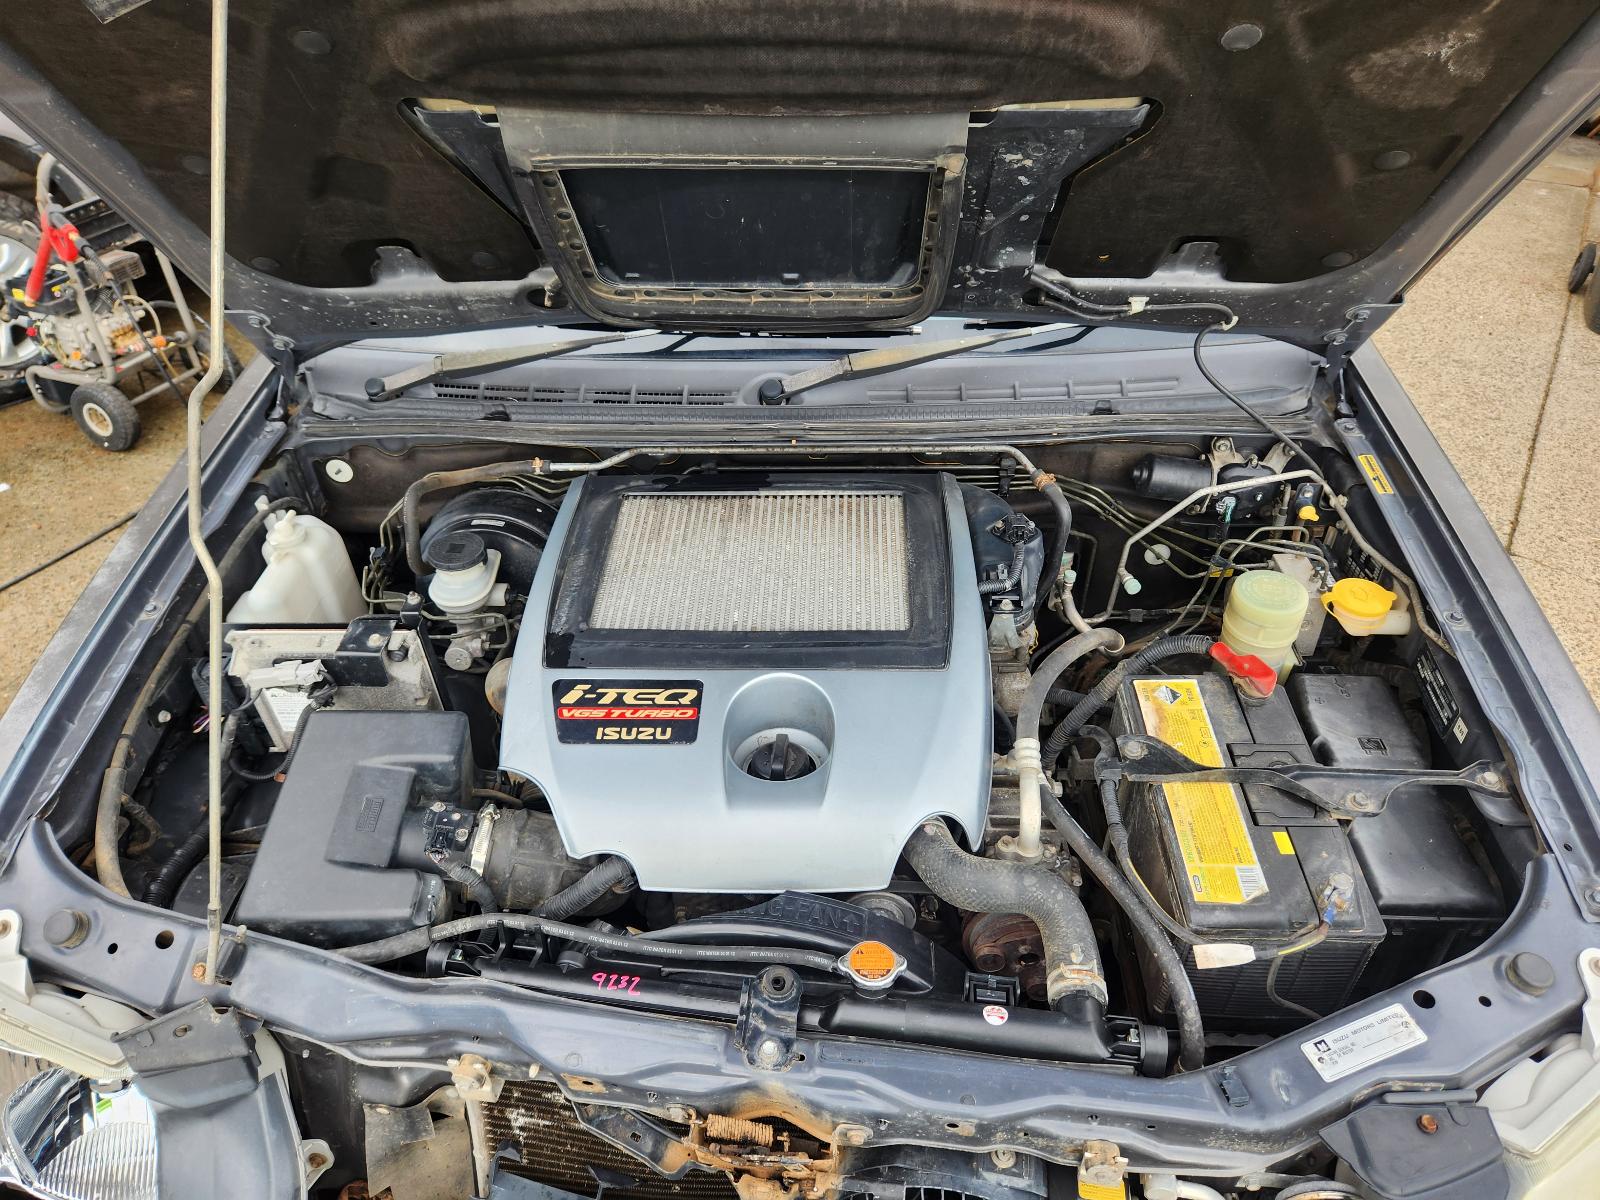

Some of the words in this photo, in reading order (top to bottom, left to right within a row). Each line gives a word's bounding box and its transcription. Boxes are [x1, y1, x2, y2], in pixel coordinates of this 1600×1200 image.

[561, 708, 607, 718] VGS
[610, 708, 694, 718] TURBO
[595, 727, 672, 740] ISUZU
[591, 972, 641, 996] 9232
